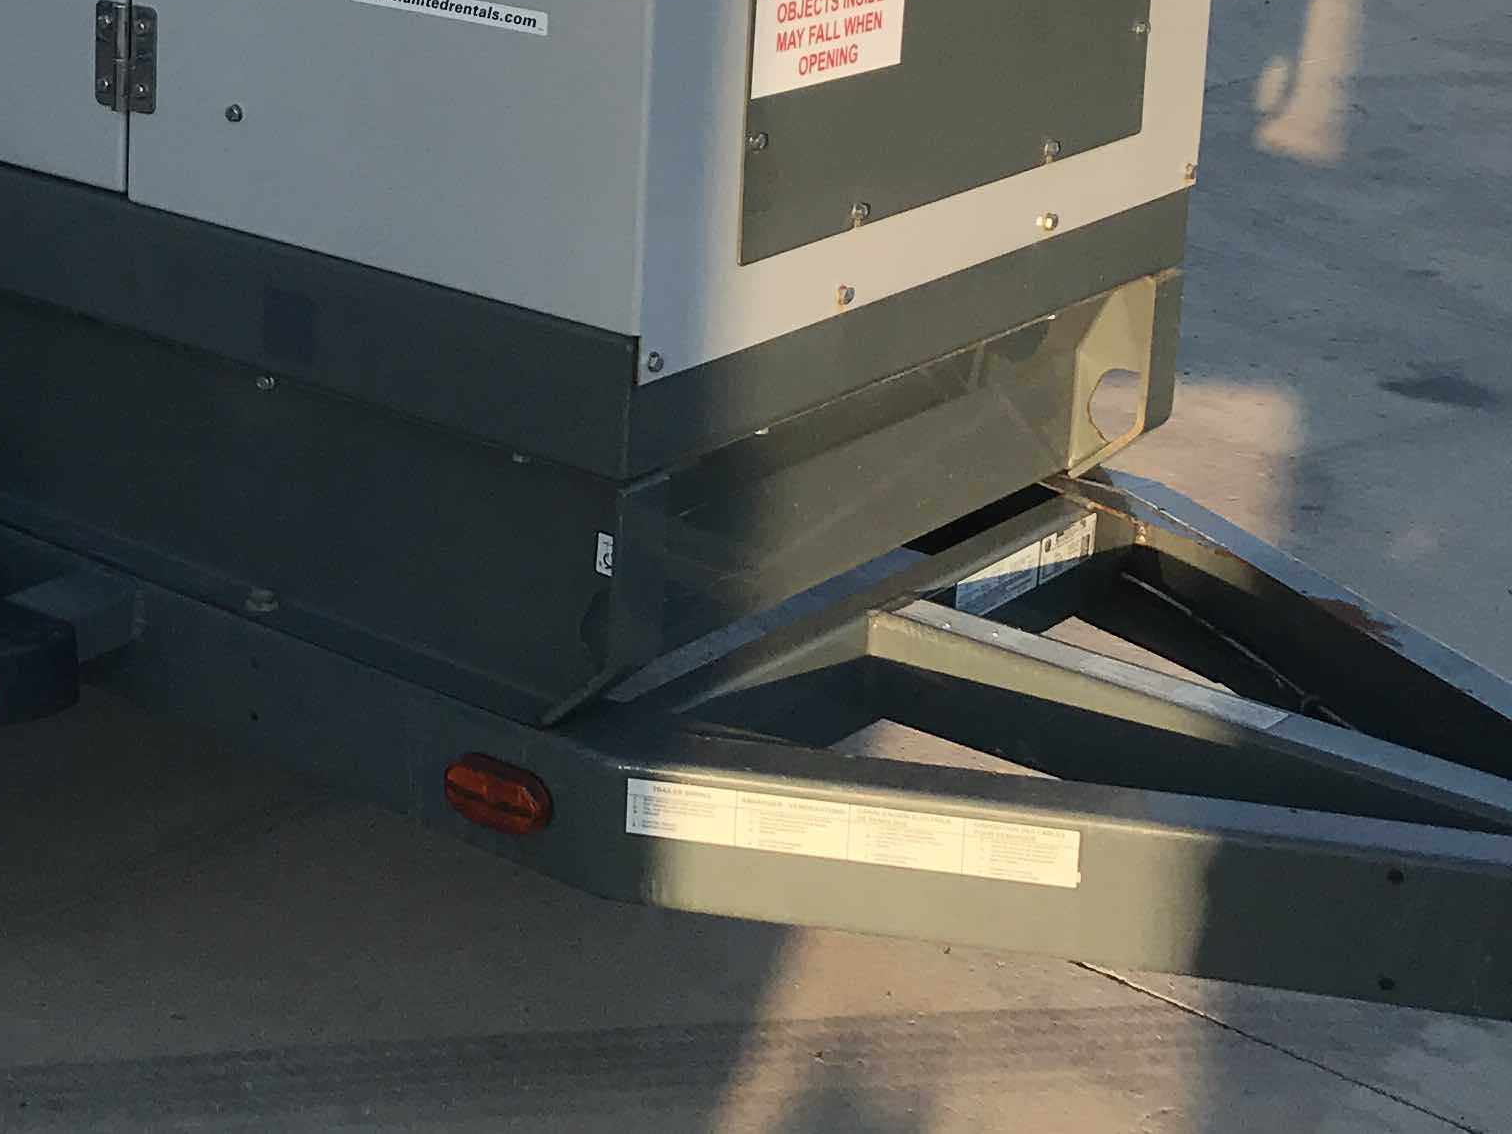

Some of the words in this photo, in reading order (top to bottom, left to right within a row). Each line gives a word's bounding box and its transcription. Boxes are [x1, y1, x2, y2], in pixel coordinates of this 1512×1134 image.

[776, 27, 805, 51] MAY
[808, 19, 841, 46] FALL
[844, 10, 883, 37] WHEN
[798, 44, 858, 76] OPENING
